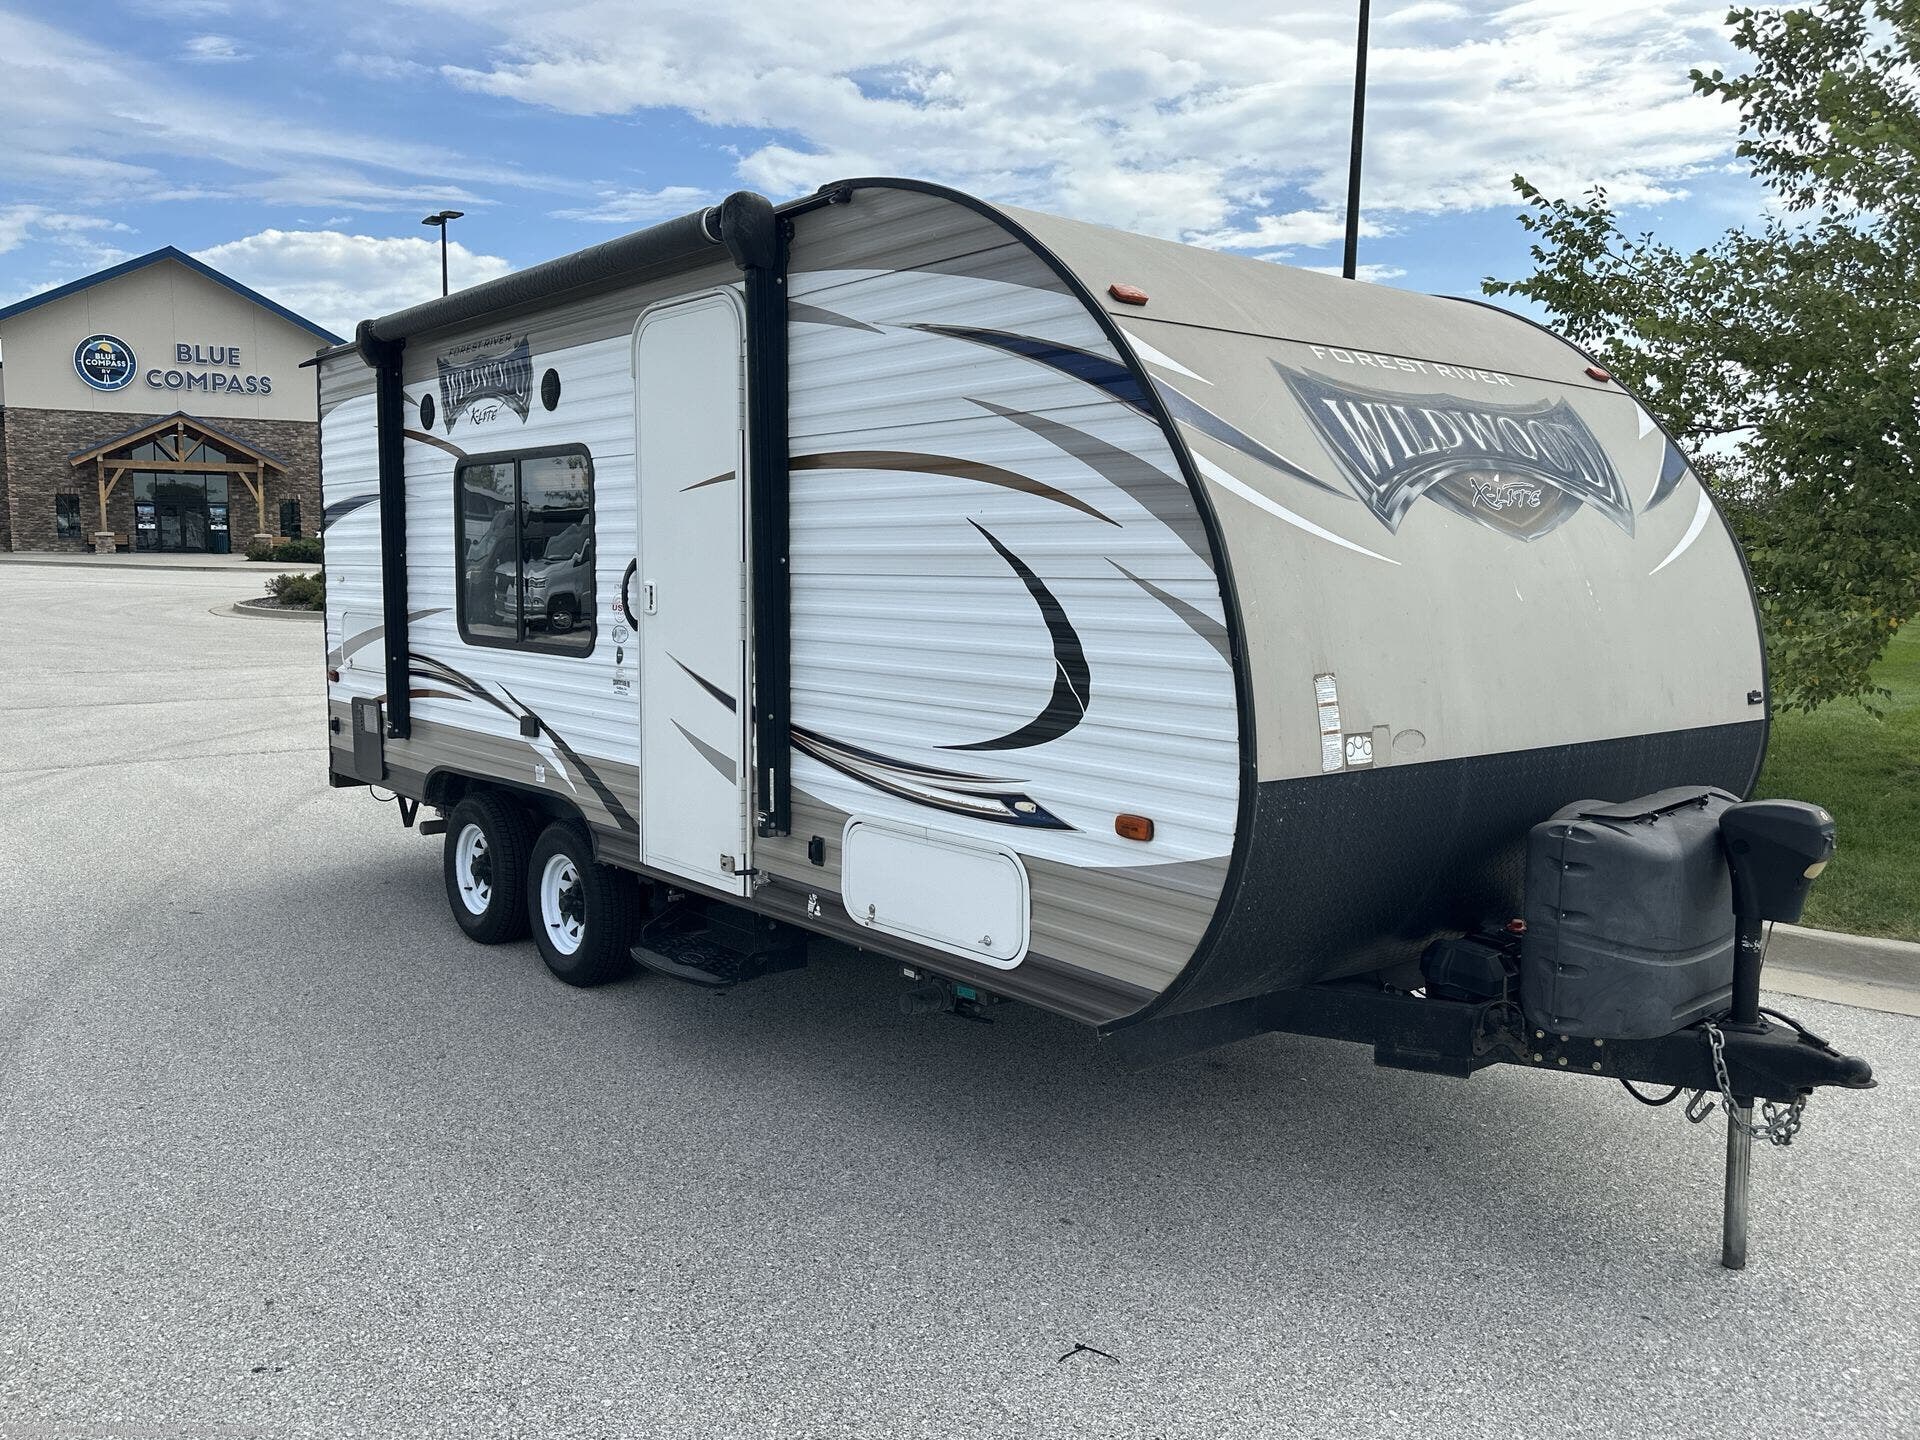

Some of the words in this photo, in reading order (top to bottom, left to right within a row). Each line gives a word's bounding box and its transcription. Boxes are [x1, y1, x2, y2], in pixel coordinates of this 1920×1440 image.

[85, 358, 127, 368] COMPASS
[94, 352, 116, 361] BLUE
[176, 342, 241, 367] BLUE
[1309, 345, 1430, 375] FOREST
[1432, 362, 1515, 388] RIVER
[145, 369, 273, 395] COMPASS
[1320, 398, 1607, 488] WILDWOOD
